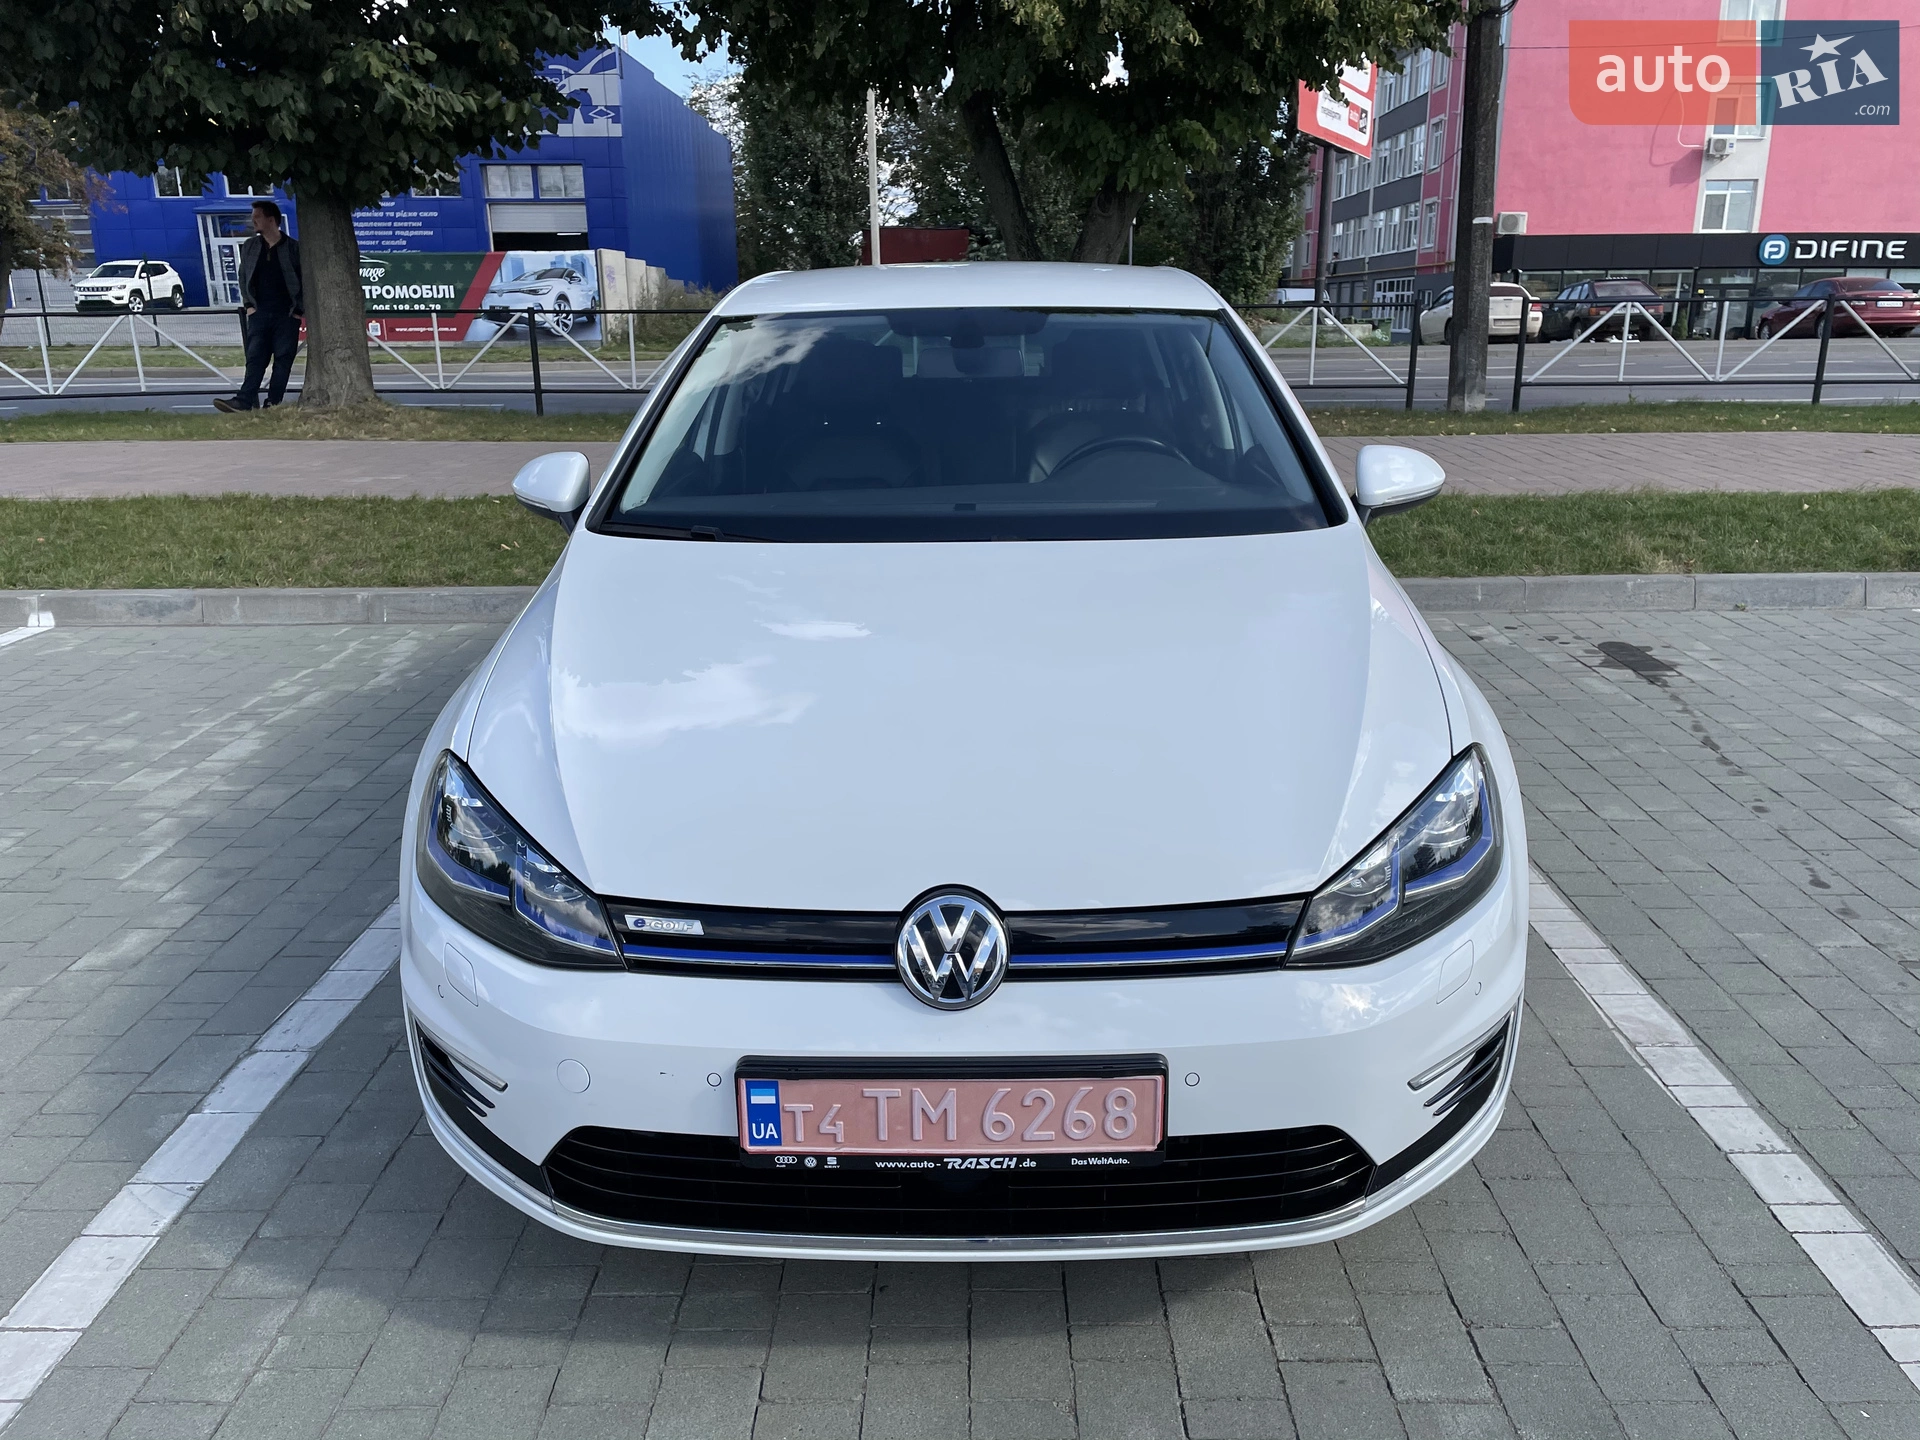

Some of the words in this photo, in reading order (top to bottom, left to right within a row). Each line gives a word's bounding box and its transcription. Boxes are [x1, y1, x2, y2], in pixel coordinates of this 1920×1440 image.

[1794, 240, 1908, 259] DIFINE
[361, 285, 455, 299] ТРОМОБІЛІ
[783, 1104, 845, 1143] T4
[862, 1087, 957, 1141] TM
[982, 1086, 1137, 1141] 6268
[752, 1123, 779, 1139] UA
